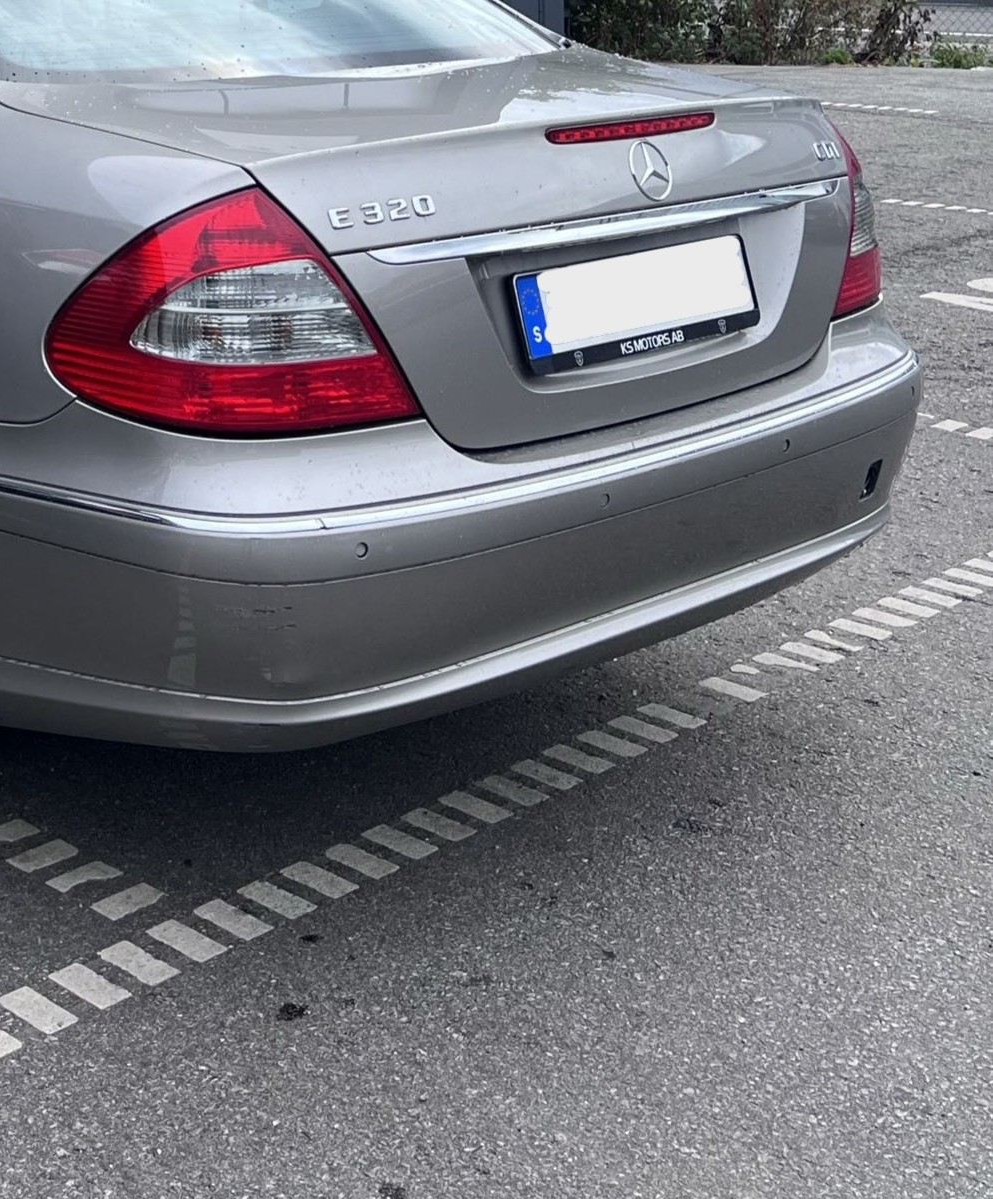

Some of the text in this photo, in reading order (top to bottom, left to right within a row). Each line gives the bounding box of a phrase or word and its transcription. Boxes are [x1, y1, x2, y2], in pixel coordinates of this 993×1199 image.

[812, 141, 840, 161] CDI
[328, 194, 437, 229] E 320
[532, 326, 543, 343] S
[620, 330, 685, 355] KS MOTORS AB
